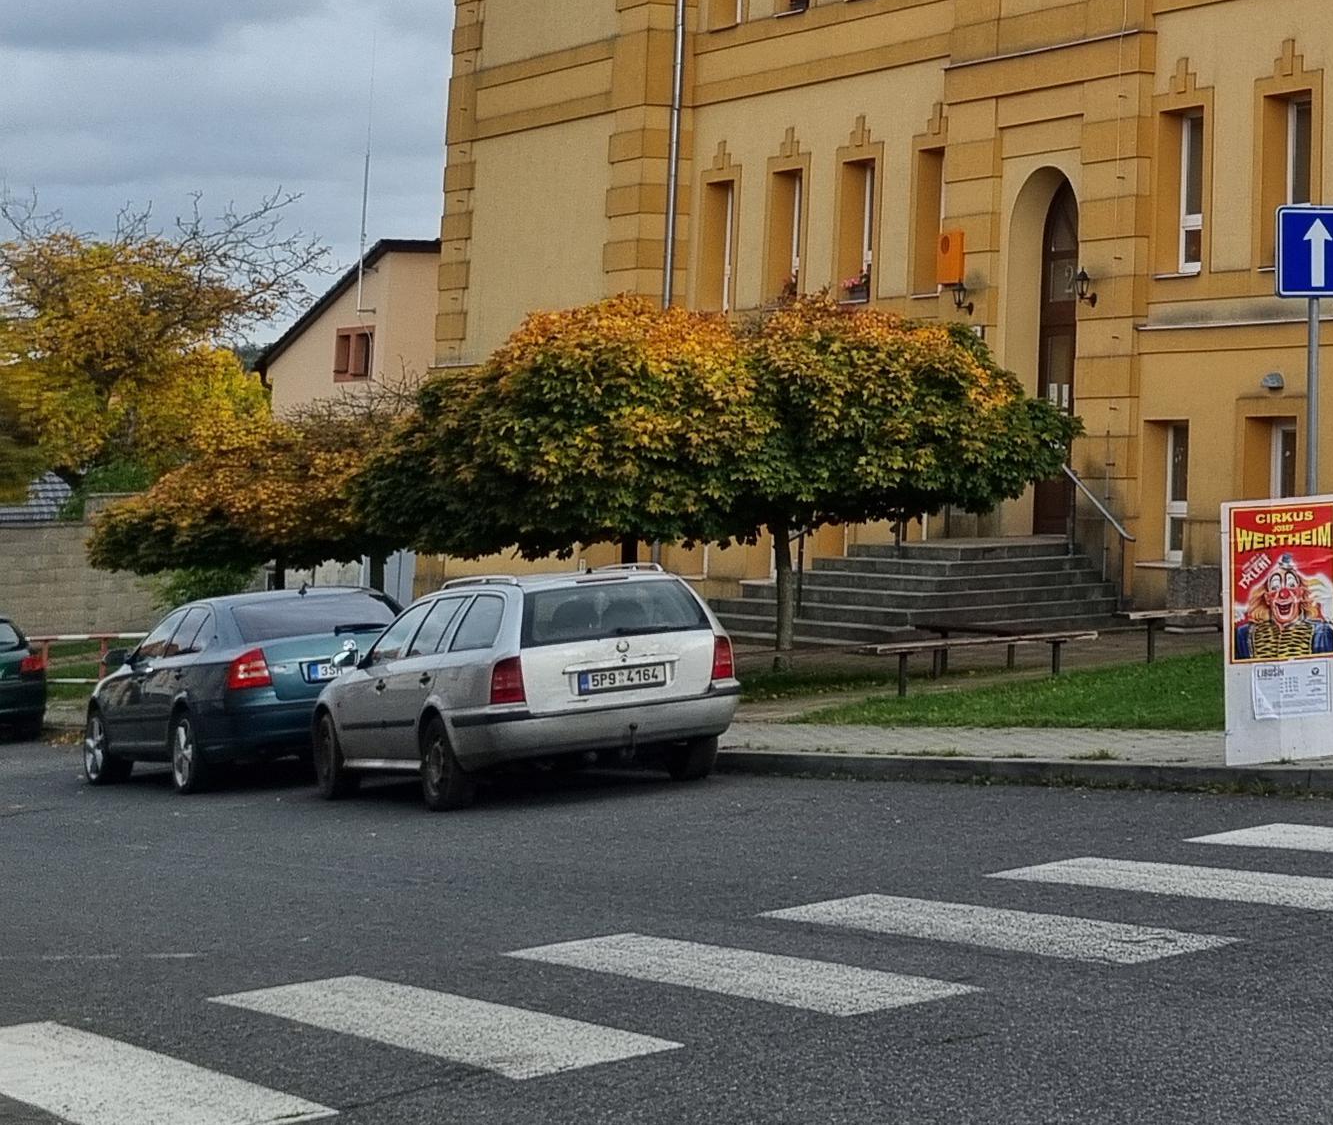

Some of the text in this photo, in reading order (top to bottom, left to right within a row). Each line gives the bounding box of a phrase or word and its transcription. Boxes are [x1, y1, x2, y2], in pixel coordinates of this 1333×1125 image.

[1255, 511, 1314, 524] CIRKUS
[1236, 522, 1332, 553] WERTHEIM
[592, 672, 616, 687] 5P9
[626, 668, 658, 683] 4164
